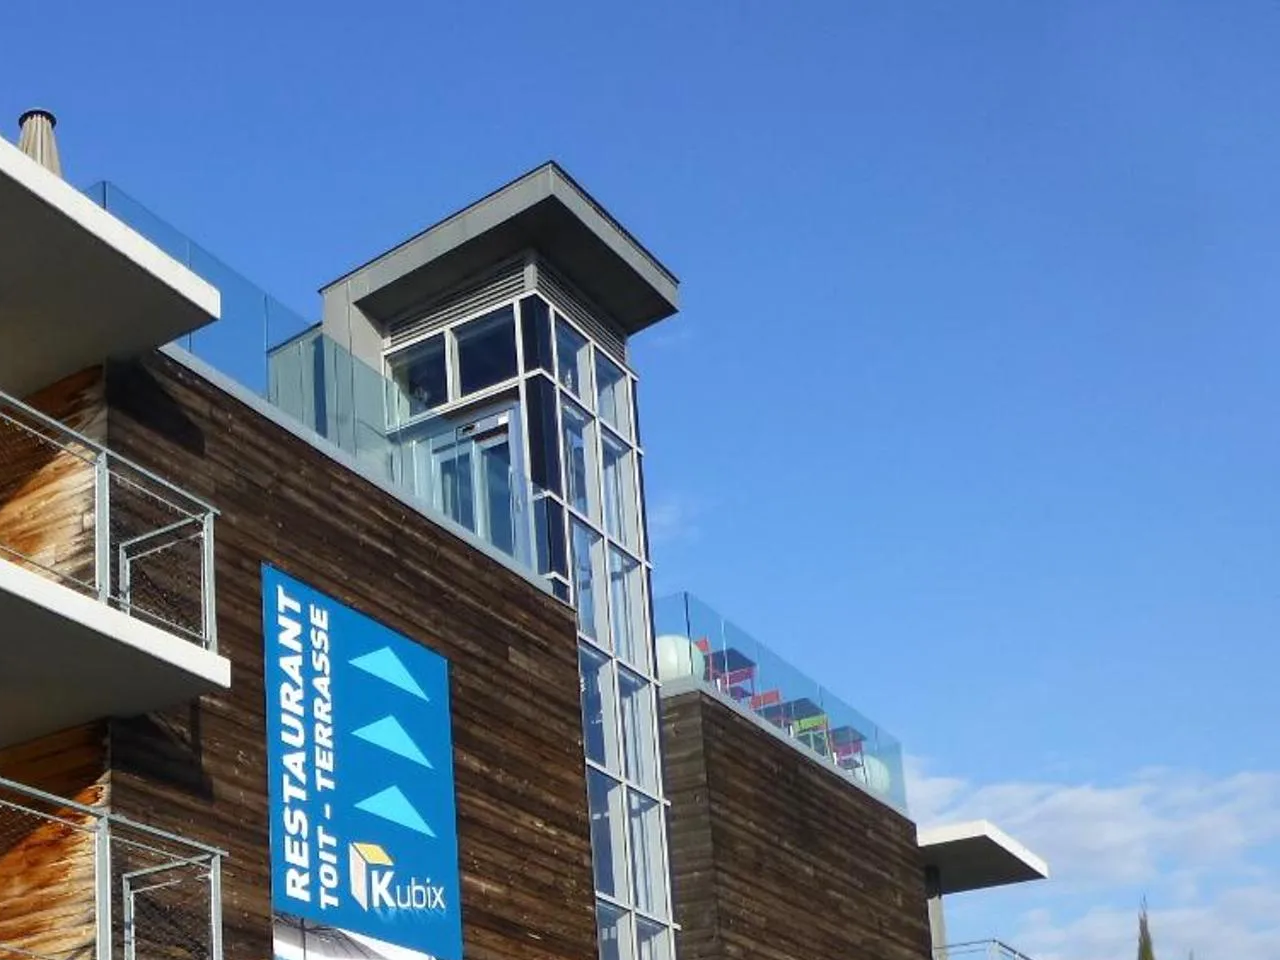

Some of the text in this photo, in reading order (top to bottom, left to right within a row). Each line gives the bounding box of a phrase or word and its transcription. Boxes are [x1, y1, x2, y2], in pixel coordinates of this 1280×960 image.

[277, 585, 311, 902] RESTAURANT
[310, 603, 335, 792] TERRASSE
[318, 825, 340, 909] TOIT
[371, 869, 446, 909] Kubix
